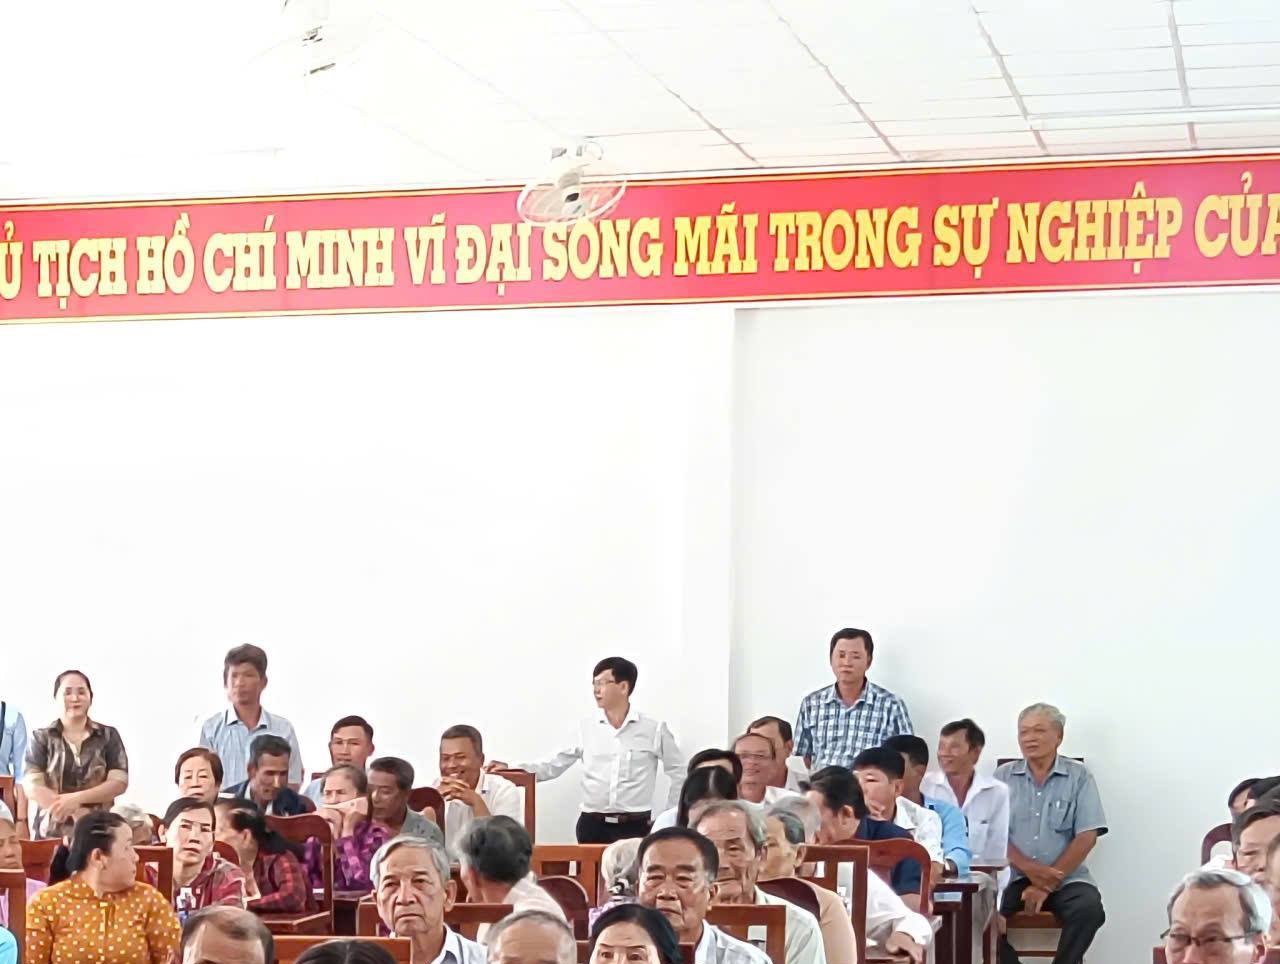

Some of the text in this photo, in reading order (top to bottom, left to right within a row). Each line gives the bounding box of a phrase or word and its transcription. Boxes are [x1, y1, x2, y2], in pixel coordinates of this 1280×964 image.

[33, 238, 127, 309] TỊCH
[137, 213, 195, 294] HỒ
[204, 215, 276, 293] CHÍ
[286, 226, 394, 289] MINH
[405, 213, 446, 285] VĨ
[456, 222, 533, 296] ĐẠI
[674, 203, 758, 276] MÃI
[770, 207, 922, 272] TRONG
[934, 198, 999, 278] SỰ
[1006, 182, 1183, 273] NGHIỆP
